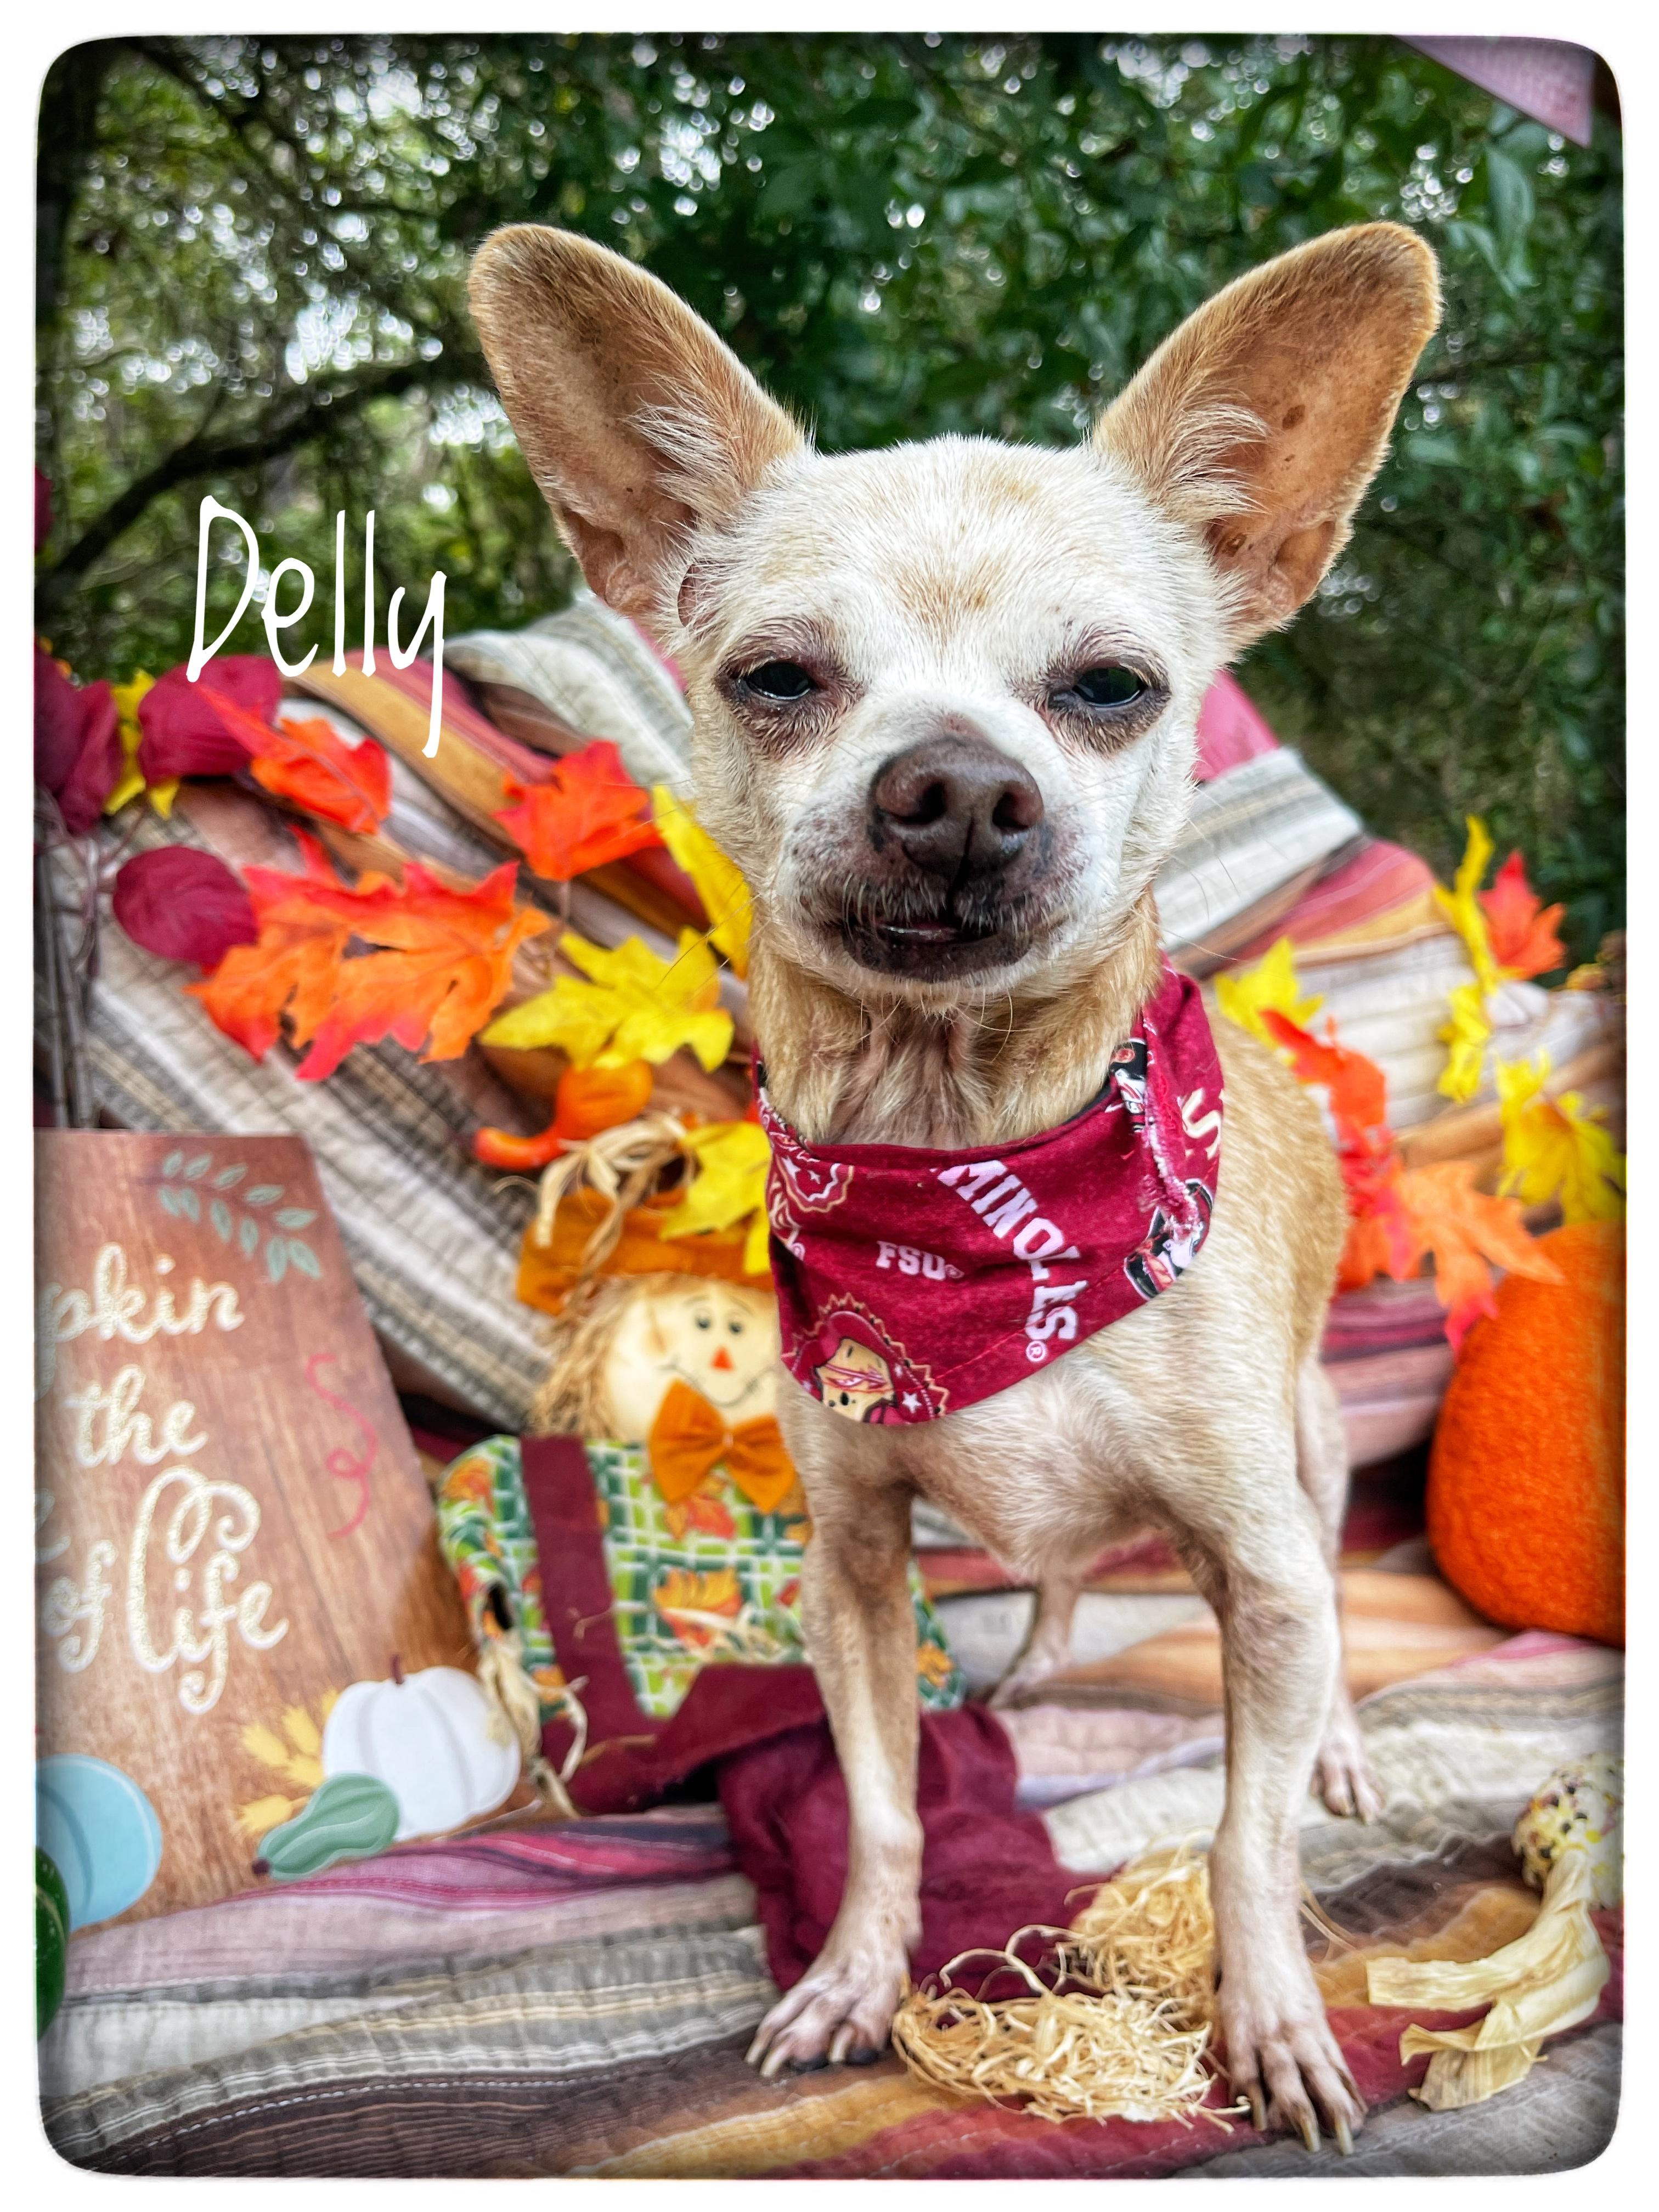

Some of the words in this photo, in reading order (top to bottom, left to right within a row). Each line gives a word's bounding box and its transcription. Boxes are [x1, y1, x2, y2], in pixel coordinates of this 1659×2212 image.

[876, 1240, 946, 1282] FSU
[64, 1363, 210, 1468] the
[41, 1538, 119, 1673] of
